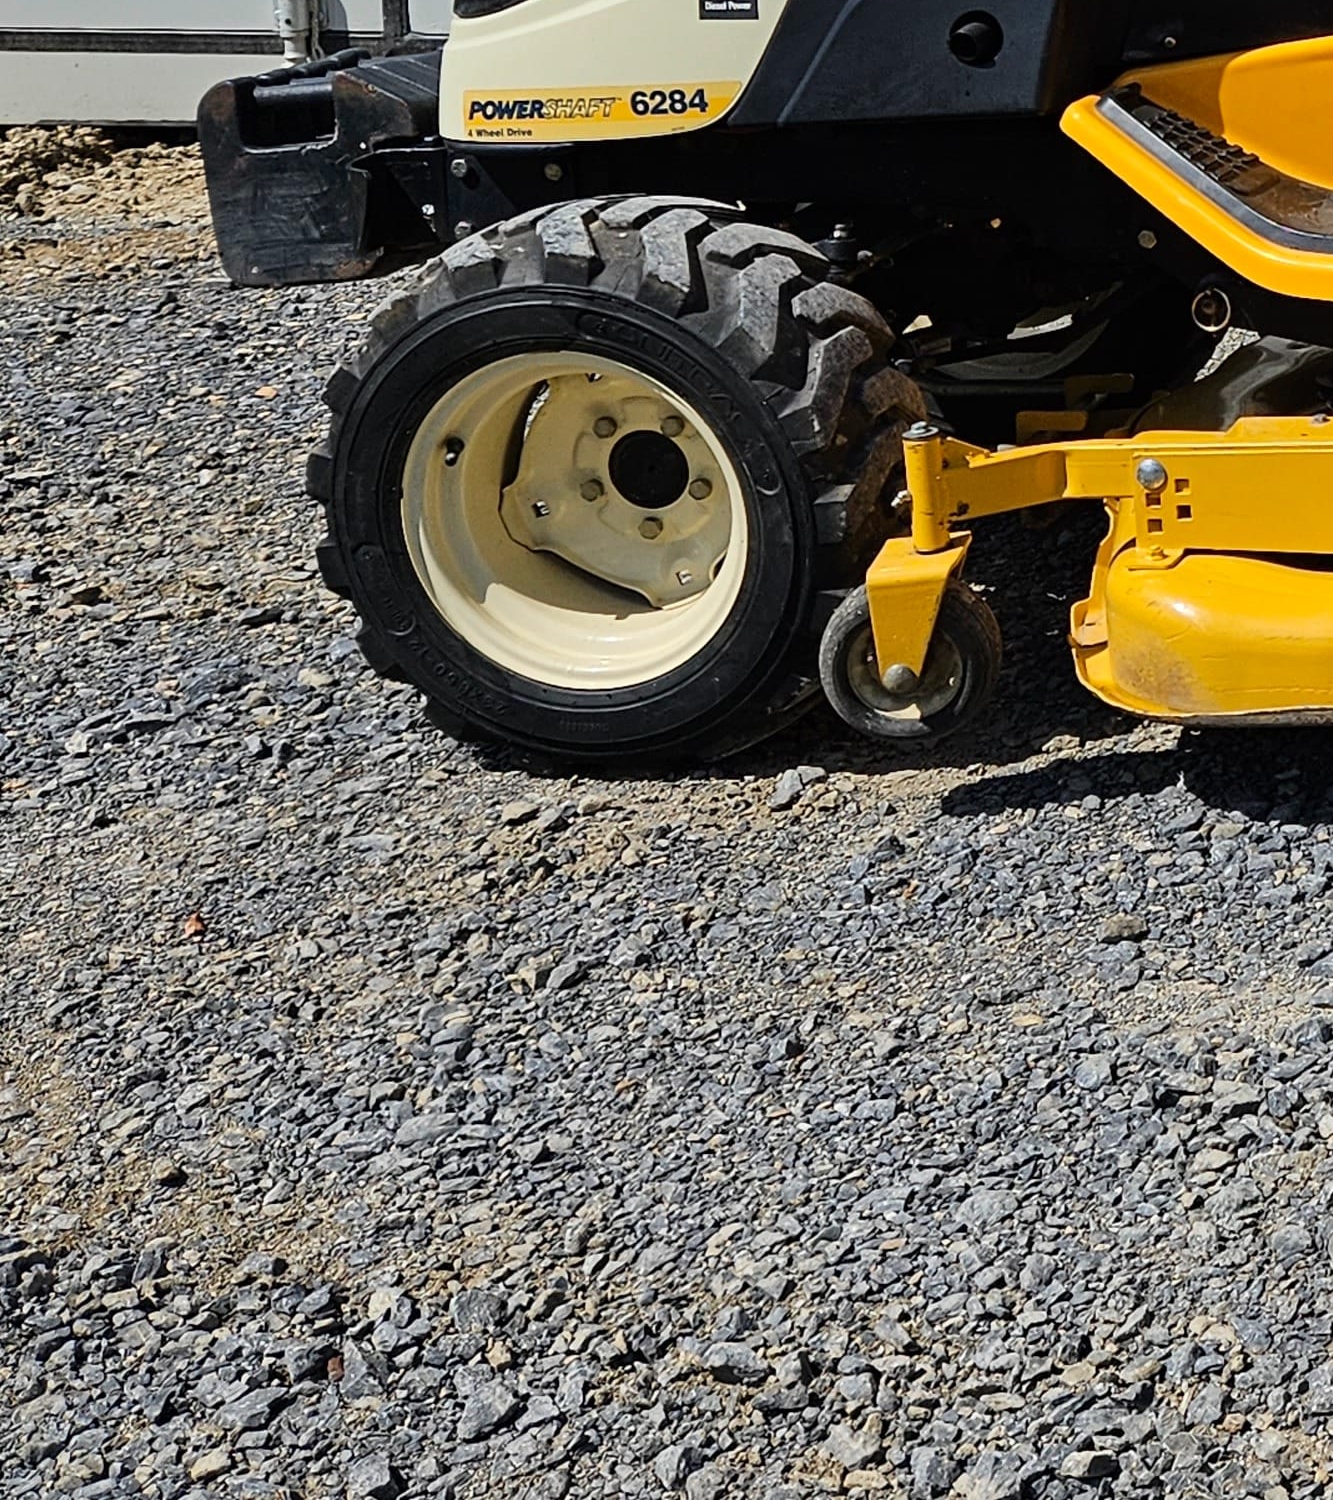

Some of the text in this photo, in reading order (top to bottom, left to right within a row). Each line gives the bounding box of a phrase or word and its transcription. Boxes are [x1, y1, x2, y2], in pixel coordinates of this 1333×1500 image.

[468, 89, 709, 120] POWERSHAFT 6284
[467, 127, 533, 138] 4 Wheel Drive
